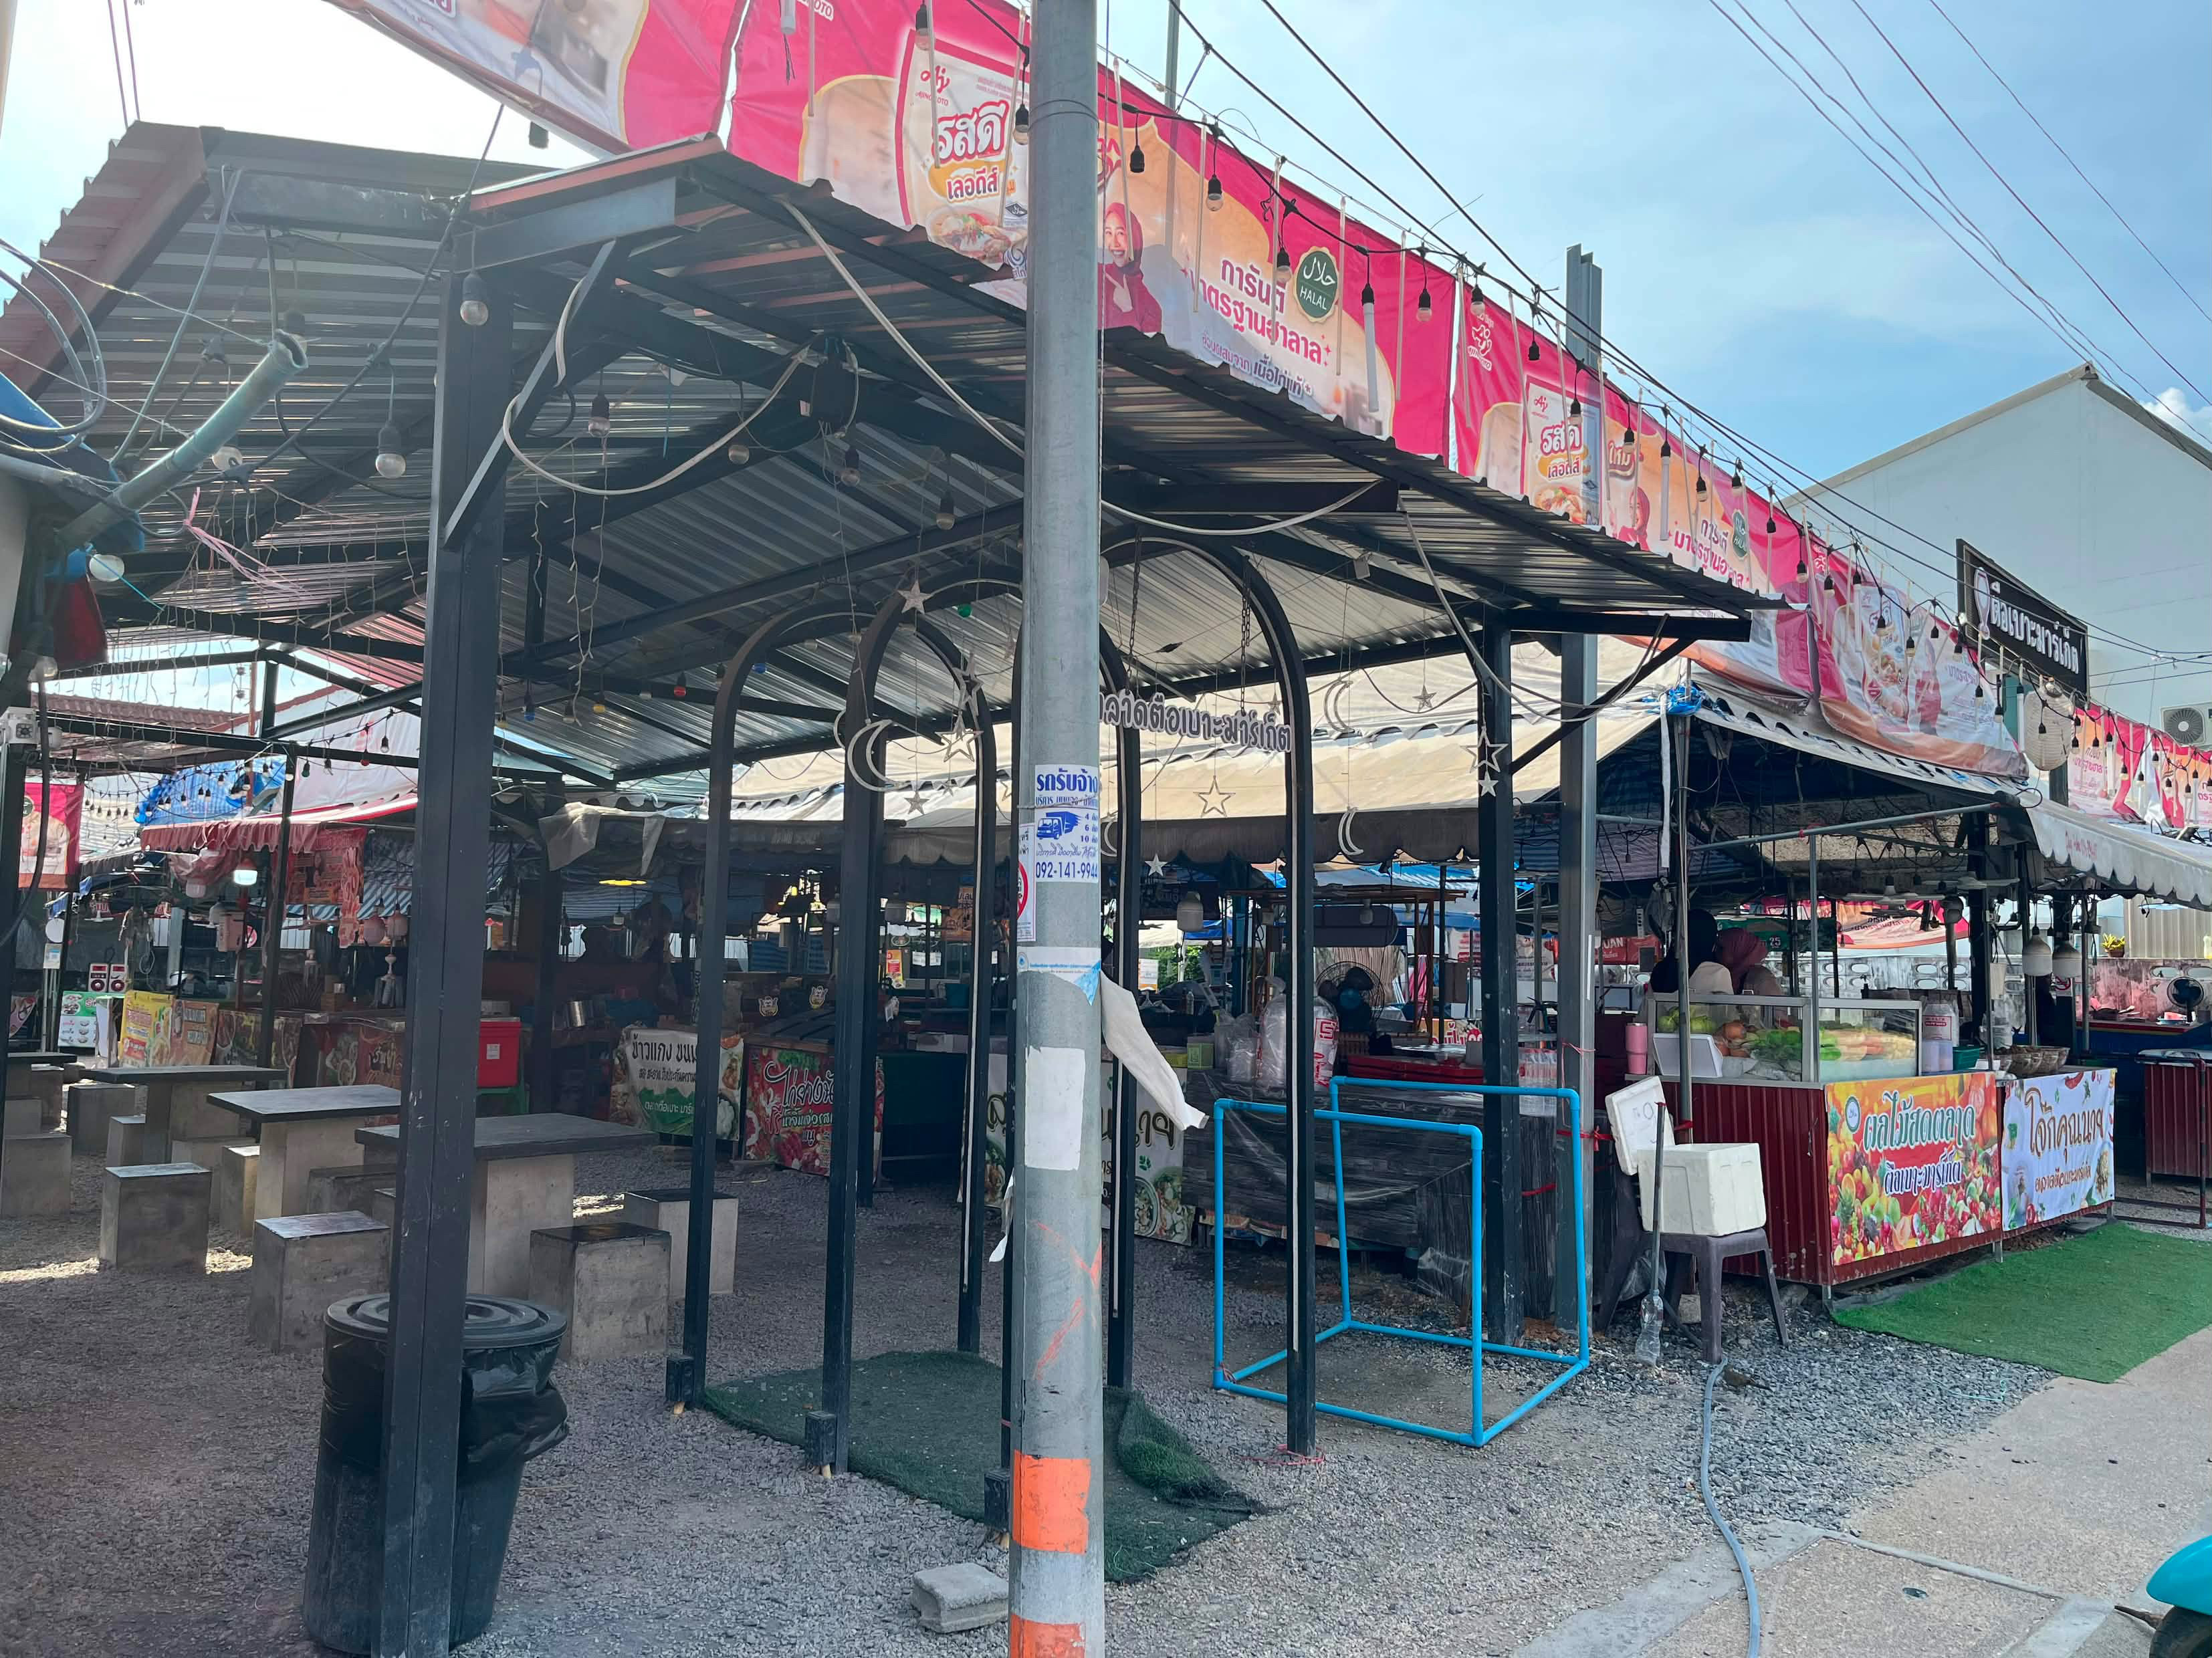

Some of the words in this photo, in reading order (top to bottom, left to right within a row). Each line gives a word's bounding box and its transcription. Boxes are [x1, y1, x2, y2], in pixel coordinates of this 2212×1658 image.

[947, 168, 1000, 201] เลอดีส์
[1303, 257, 1335, 286] حلال
[1299, 285, 1327, 311] HALAL
[1036, 767, 1097, 793] รถรับจ้าง
[632, 1034, 672, 1062] ข้าวแกง
[1863, 1090, 1976, 1153] ผลไม้สดตลาด
